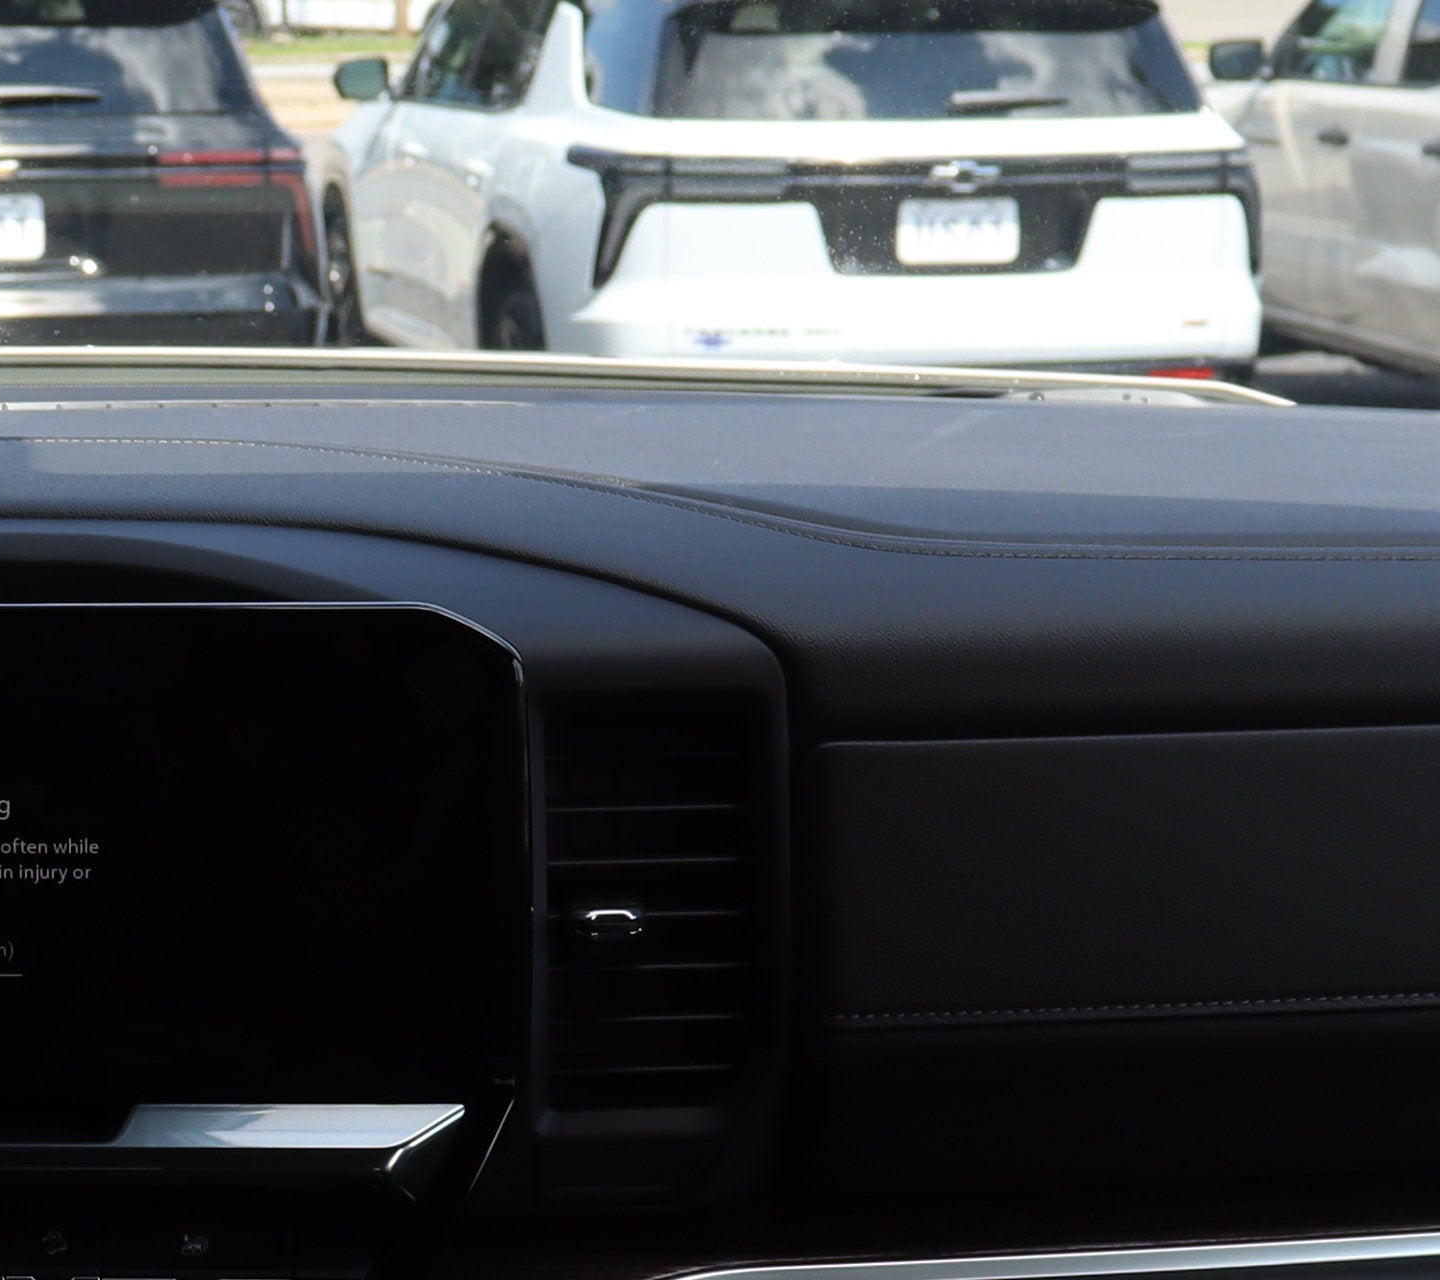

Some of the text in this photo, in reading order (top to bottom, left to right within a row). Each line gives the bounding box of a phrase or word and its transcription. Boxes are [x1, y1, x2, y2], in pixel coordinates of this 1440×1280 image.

[0, 837, 48, 854] often
[52, 837, 99, 854] while
[18, 864, 68, 884] injury
[72, 867, 91, 879] or
